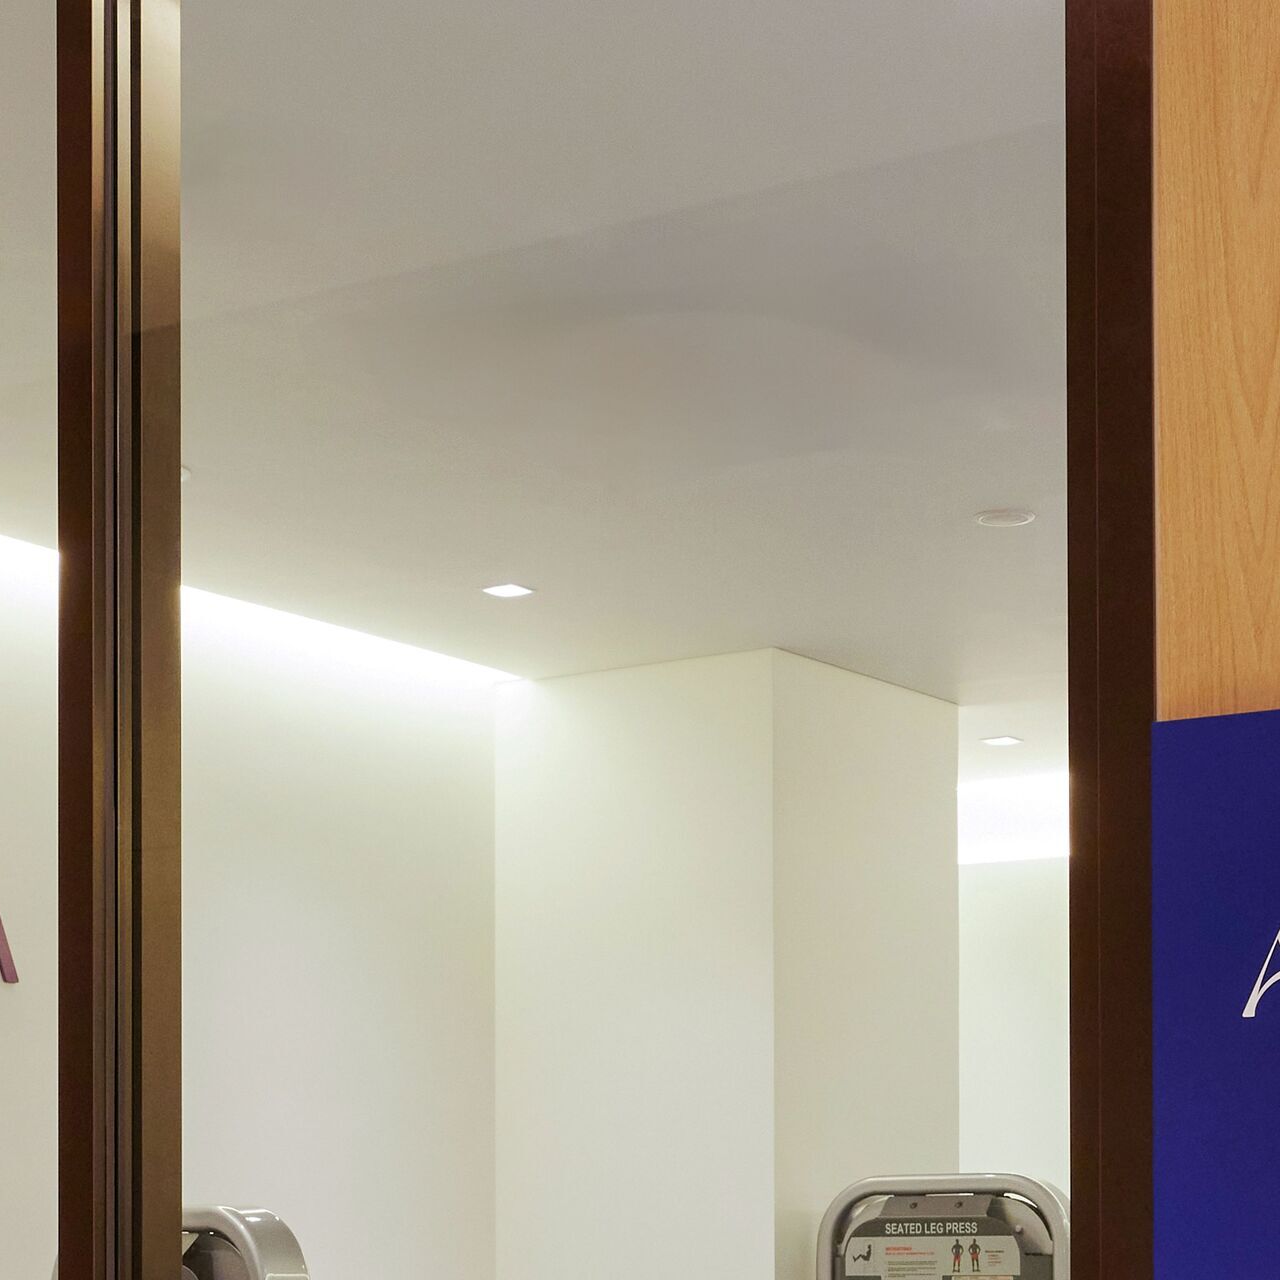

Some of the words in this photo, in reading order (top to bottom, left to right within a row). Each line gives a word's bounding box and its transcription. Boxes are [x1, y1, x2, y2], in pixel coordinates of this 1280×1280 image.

[885, 1222, 922, 1235] SEATED
[924, 1222, 944, 1234] LEG
[945, 1221, 978, 1234] PRESS
